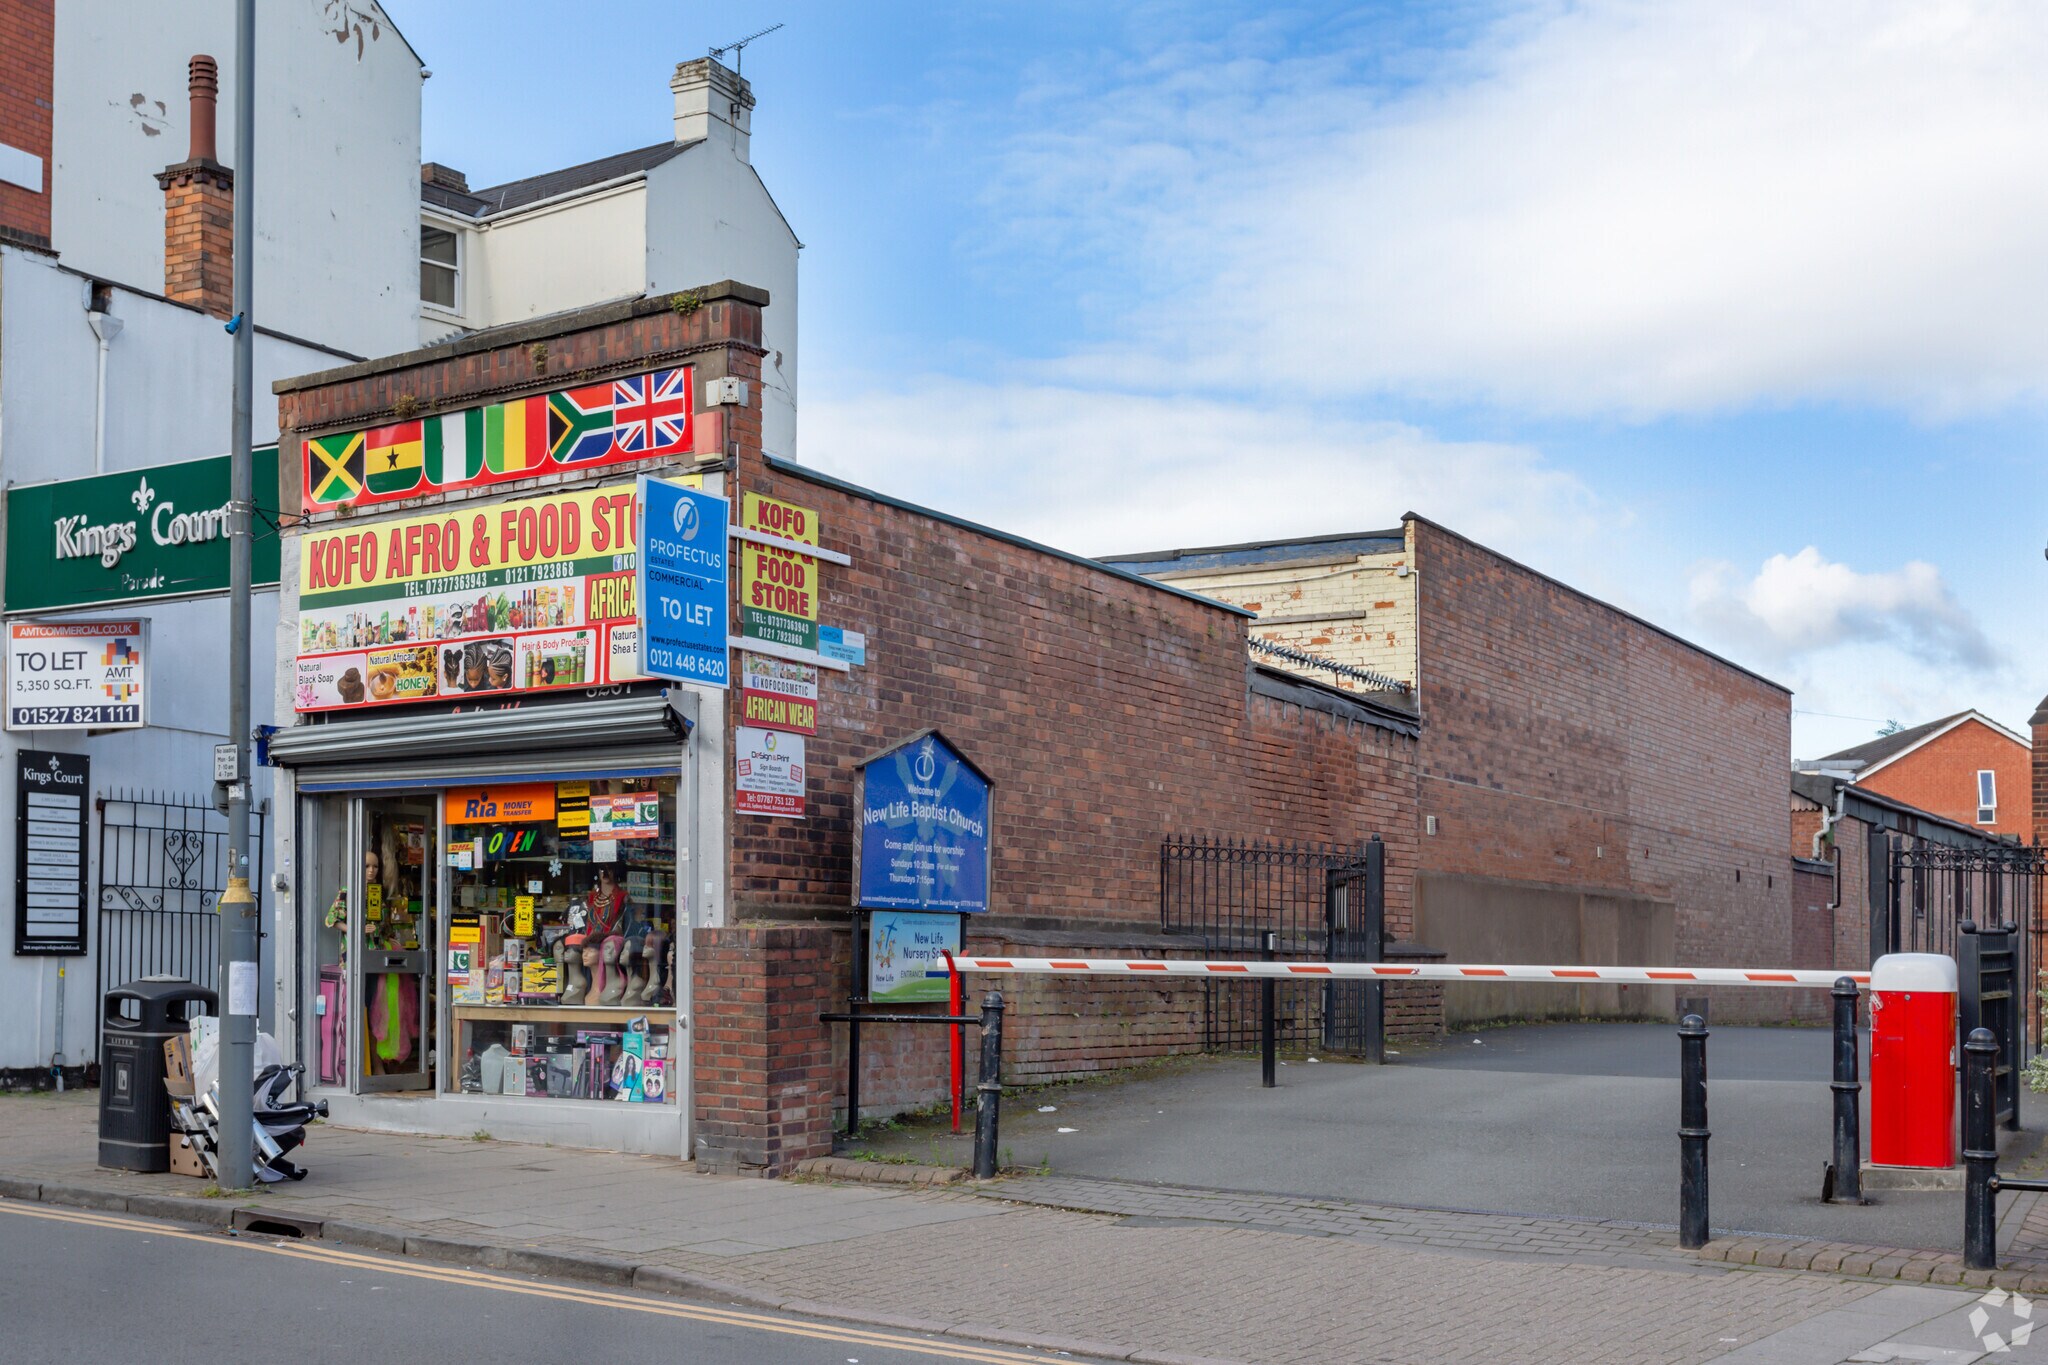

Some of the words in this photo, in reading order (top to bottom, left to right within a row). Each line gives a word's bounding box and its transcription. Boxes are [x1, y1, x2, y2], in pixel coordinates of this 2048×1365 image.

[758, 499, 805, 536] KOFO
[55, 515, 137, 568] Kings
[151, 501, 232, 546] Court
[309, 531, 378, 589] KOFO
[386, 519, 460, 579] AFRO
[470, 514, 490, 567] &
[501, 502, 580, 563] FOOD
[650, 538, 721, 568] PROFECTUS
[651, 556, 675, 568] ESTATES
[122, 568, 165, 591] Parade
[405, 581, 423, 597] TEL:
[426, 572, 487, 594] 07377363943
[505, 566, 528, 584] 0121
[532, 561, 574, 581] 7923868
[757, 554, 805, 589] FOOD
[649, 570, 704, 591] COMMERCIAL
[590, 575, 636, 619] AFRICA
[751, 580, 809, 617] STORE
[660, 596, 682, 620] TO
[686, 602, 714, 627] LET
[20, 625, 132, 637] AMTCOMMERCIAL.CO.UK
[752, 612, 767, 625] TEL:
[768, 615, 809, 634] 07377363943
[521, 642, 535, 651] Hair
[542, 640, 560, 651] Body
[561, 638, 590, 647] Products
[612, 631, 637, 641] Natura
[651, 634, 725, 654] www.profectusestates.com
[758, 626, 775, 639] 0121
[777, 629, 803, 646] 7923868
[612, 644, 631, 655] Shea
[16, 652, 46, 672] TO
[52, 651, 88, 671] LET
[298, 662, 322, 672] Natural
[369, 653, 391, 666] Natural
[392, 651, 416, 663] African
[650, 648, 673, 669] 0121
[675, 653, 696, 672] 448
[698, 657, 724, 678] 6420
[105, 666, 133, 678] AMT
[298, 675, 317, 685] Black
[317, 673, 334, 684] Soap
[16, 679, 50, 692] 5,350
[54, 678, 92, 690] SQ.FT.
[396, 676, 430, 692] HONEY
[760, 676, 809, 697] KOFOCOSMETIC
[19, 708, 69, 723] 01527
[73, 707, 101, 722] 821
[107, 706, 133, 721] 111
[746, 696, 786, 724] AFRICAN
[788, 702, 815, 729] WEAR
[23, 767, 52, 785] Kings
[54, 770, 83, 784] Court
[746, 793, 756, 802] Tel:
[774, 796, 784, 805] 751
[908, 784, 934, 796] Welcome
[934, 788, 941, 797] to
[465, 792, 497, 818] Ria
[503, 801, 533, 809] MONEY
[613, 798, 634, 806] GHANA
[864, 807, 887, 826] New
[889, 801, 909, 818] Life
[911, 801, 947, 822] Baptist
[949, 808, 983, 838] Church
[488, 830, 538, 854] OPEN
[884, 839, 902, 850] Come
[902, 842, 913, 850] and
[914, 842, 925, 853] join
[933, 843, 942, 853] for
[942, 845, 965, 857] worship:
[891, 858, 912, 869] Sundays
[914, 860, 934, 870] 10:30am
[889, 873, 916, 885] Thursdays
[916, 875, 935, 886] 7:15pm
[915, 932, 929, 944] New
[931, 932, 944, 944] Life
[903, 948, 930, 962] Nursery
[932, 947, 954, 959] Schl
[875, 974, 885, 982] New
[886, 974, 894, 982] Life
[900, 970, 924, 979] ENTRANCE
[111, 1037, 134, 1046] LITTER
